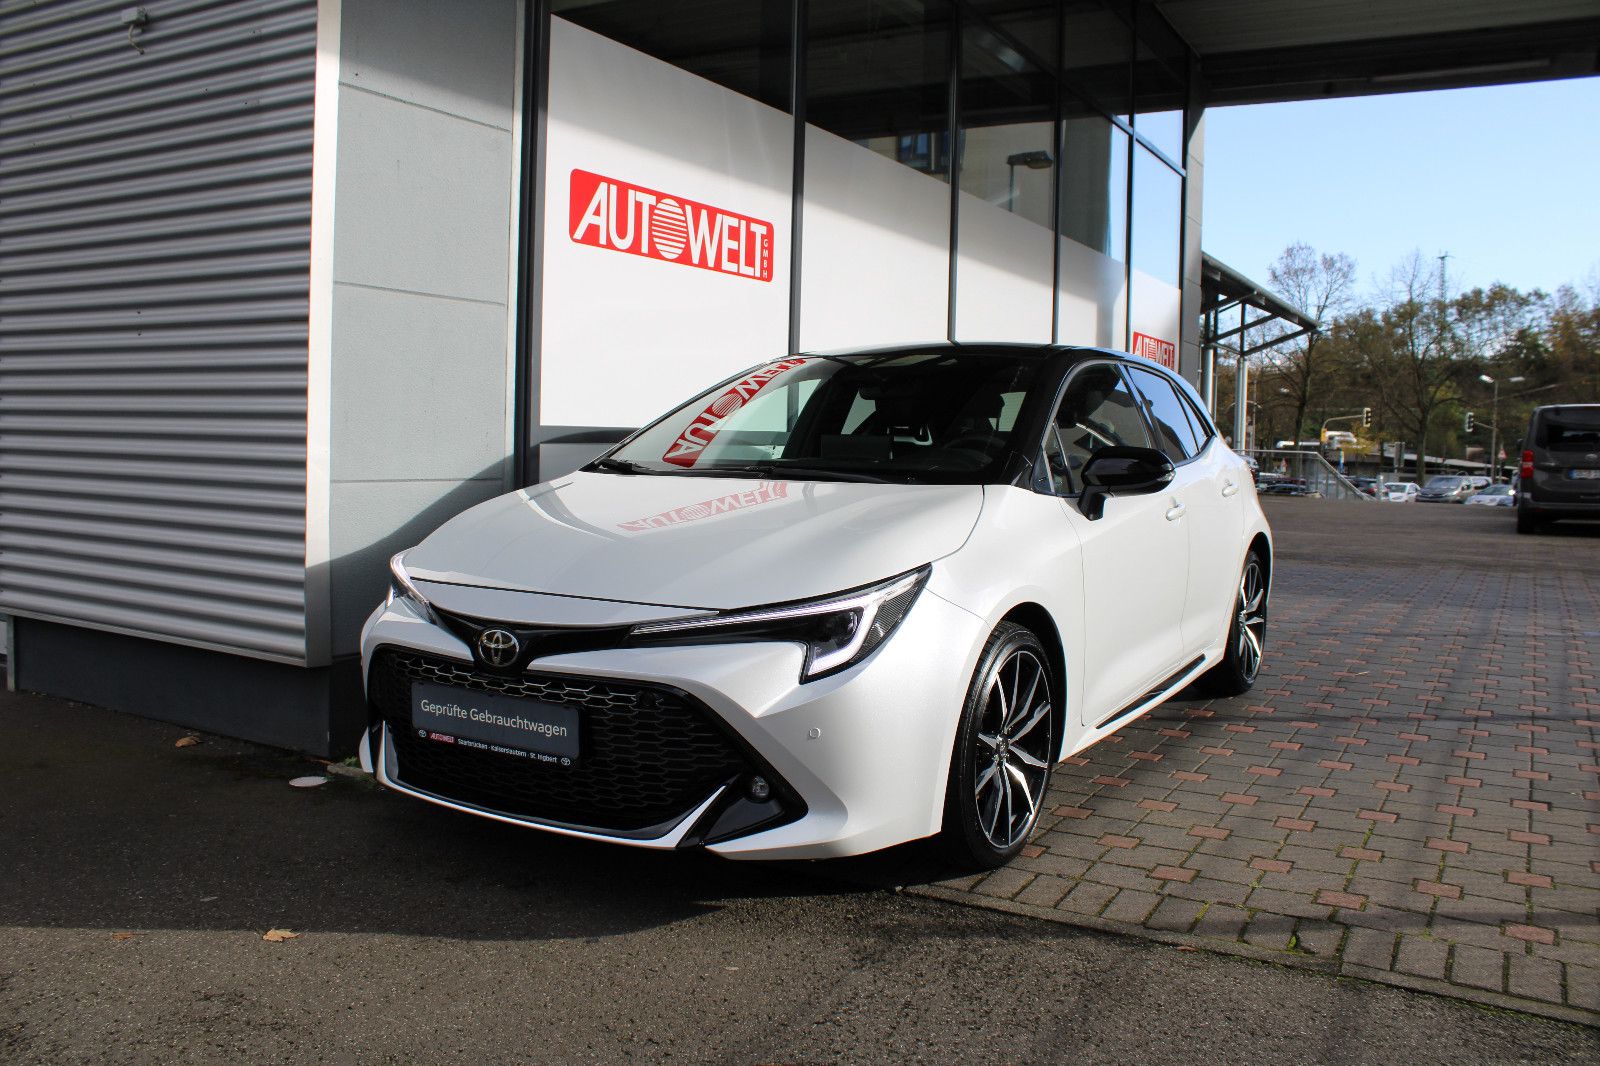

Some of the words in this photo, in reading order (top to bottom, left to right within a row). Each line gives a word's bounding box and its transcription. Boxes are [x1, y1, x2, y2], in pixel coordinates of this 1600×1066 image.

[573, 178, 767, 278] AUTOWELT
[421, 700, 468, 719] Geprüfte
[469, 708, 567, 737] Gebrauchtwagen
